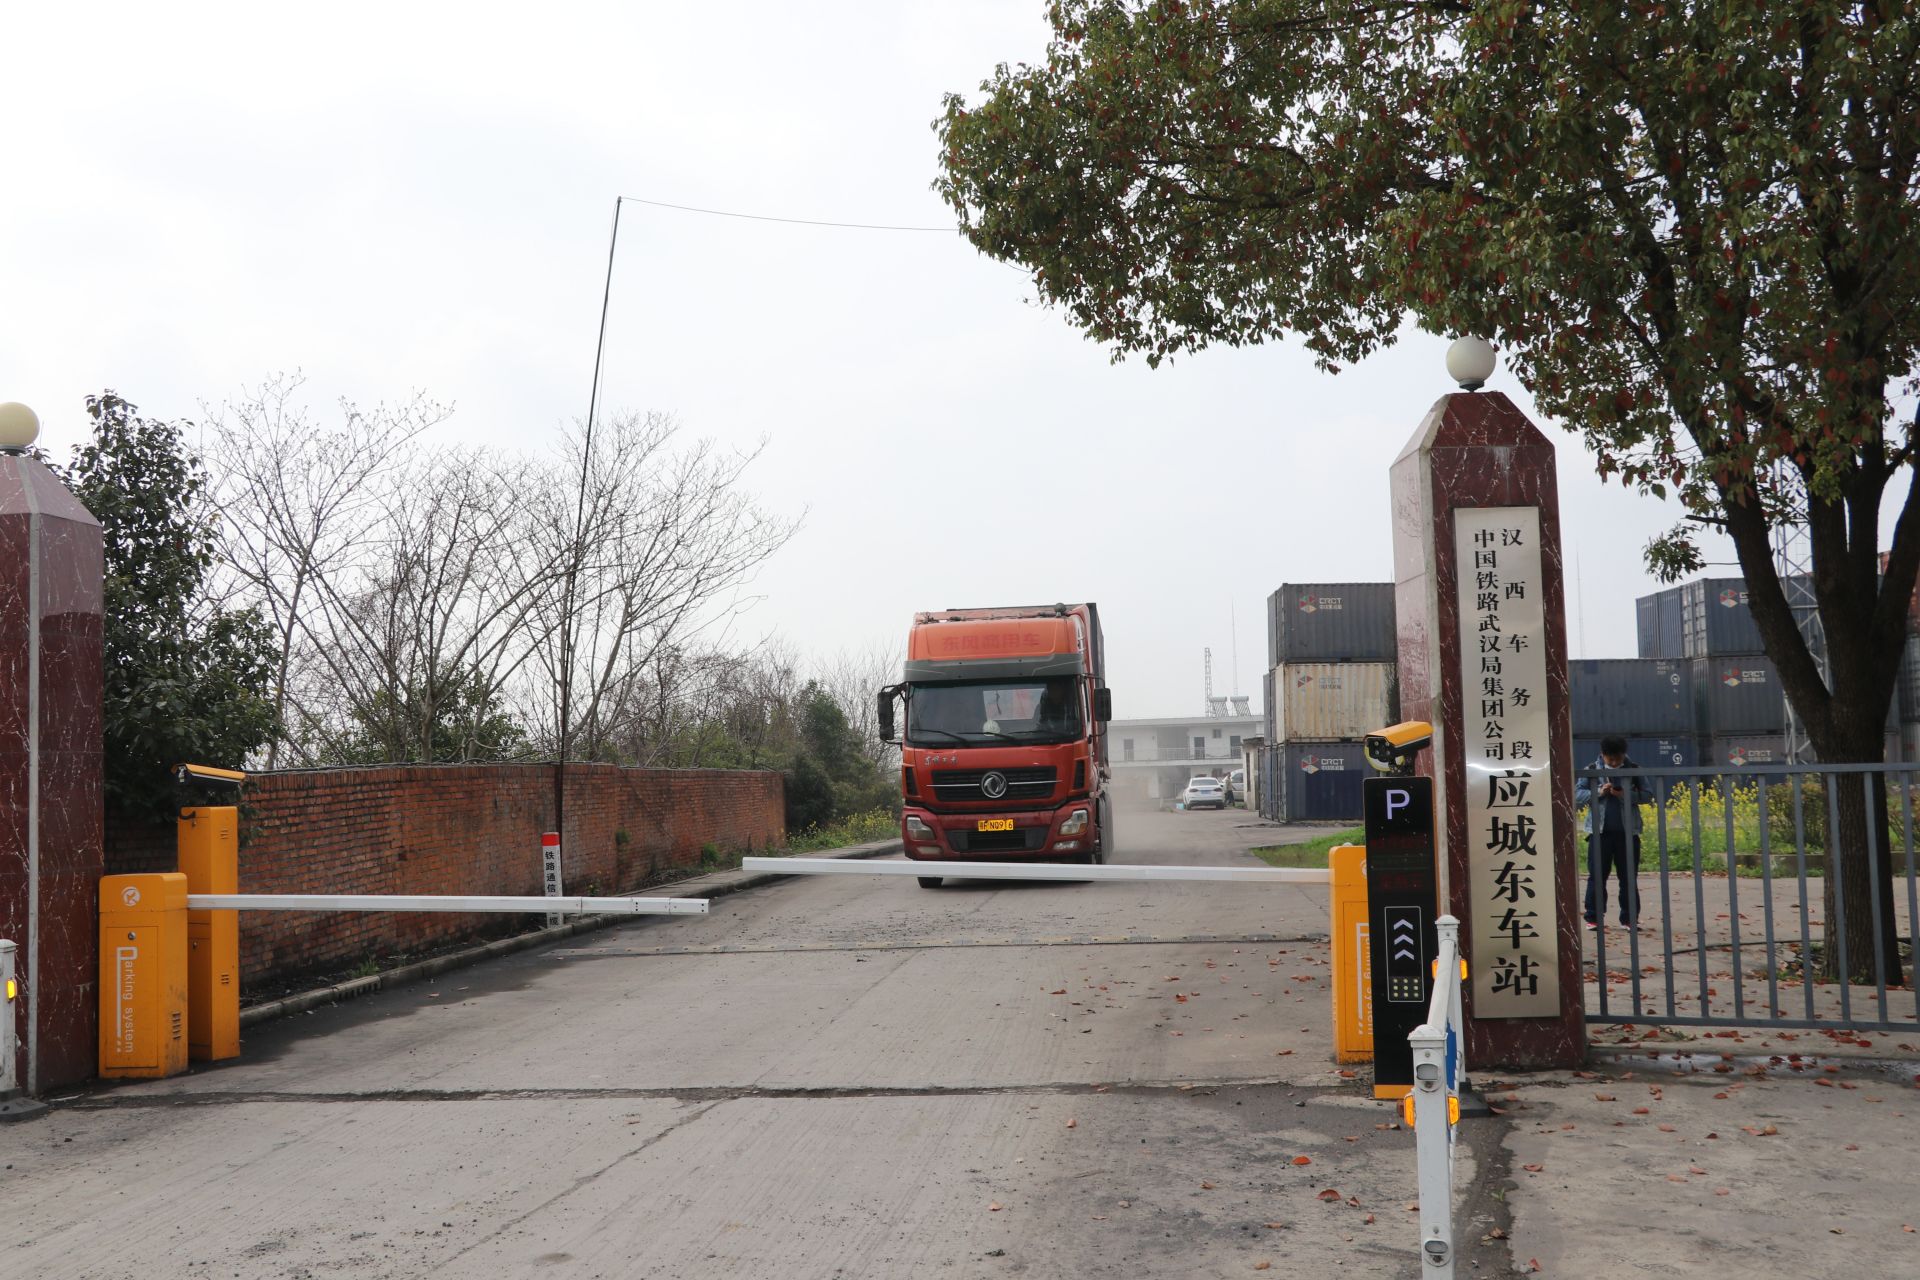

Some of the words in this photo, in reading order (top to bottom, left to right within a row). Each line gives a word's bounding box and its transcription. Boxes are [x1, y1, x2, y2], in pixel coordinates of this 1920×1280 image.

[943, 632, 1041, 651] 东风商用车
[1473, 528, 1504, 761] 中国铁路武汉局集团公司
[1500, 528, 1532, 760] 汉西车务段
[1385, 788, 1411, 820] P
[545, 851, 559, 926] 铁路通信缆
[1486, 769, 1539, 996] 应城东车站
[122, 1007, 134, 1053] system
